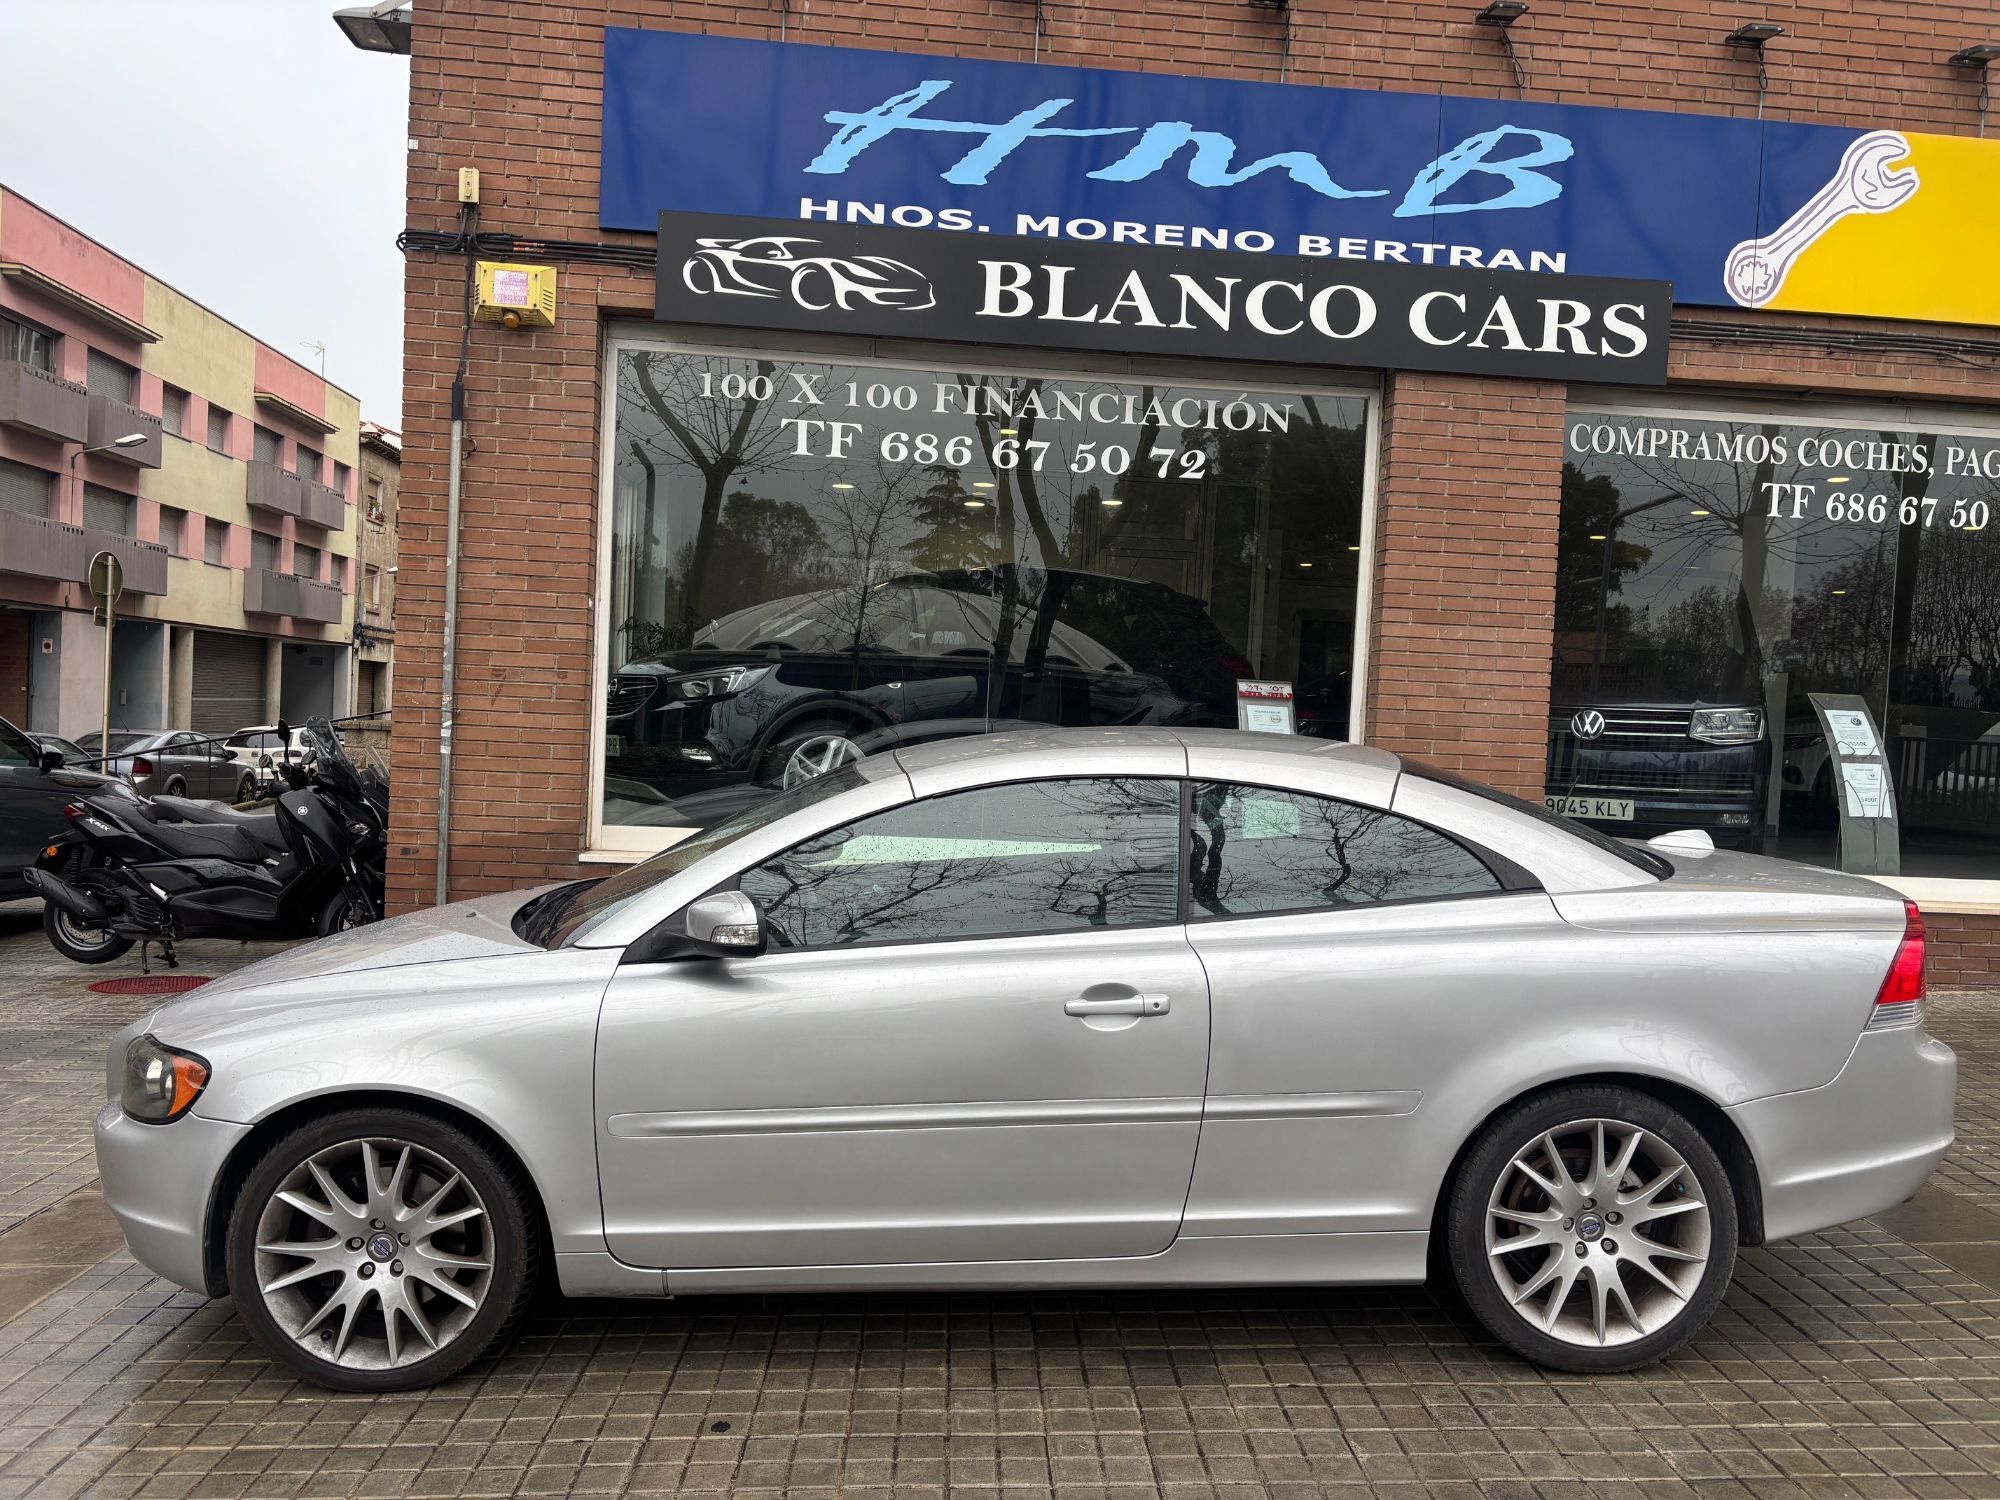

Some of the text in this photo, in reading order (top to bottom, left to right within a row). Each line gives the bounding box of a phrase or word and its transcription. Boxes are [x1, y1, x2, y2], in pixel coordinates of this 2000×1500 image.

[801, 198, 1566, 273] HNOS. MORENO BERTRAN
[976, 261, 1647, 357] BLANCO CARS
[700, 371, 1294, 434] 100 X 100 FINANCIACIÓN
[780, 418, 1206, 480] TF 686 67 50 72
[1570, 424, 1788, 465] COMPRAMOS
[1797, 438, 1935, 479] COCHES,
[1761, 483, 1990, 530] TF 686 67 50
[1545, 798, 1629, 817] 9045 KLY
